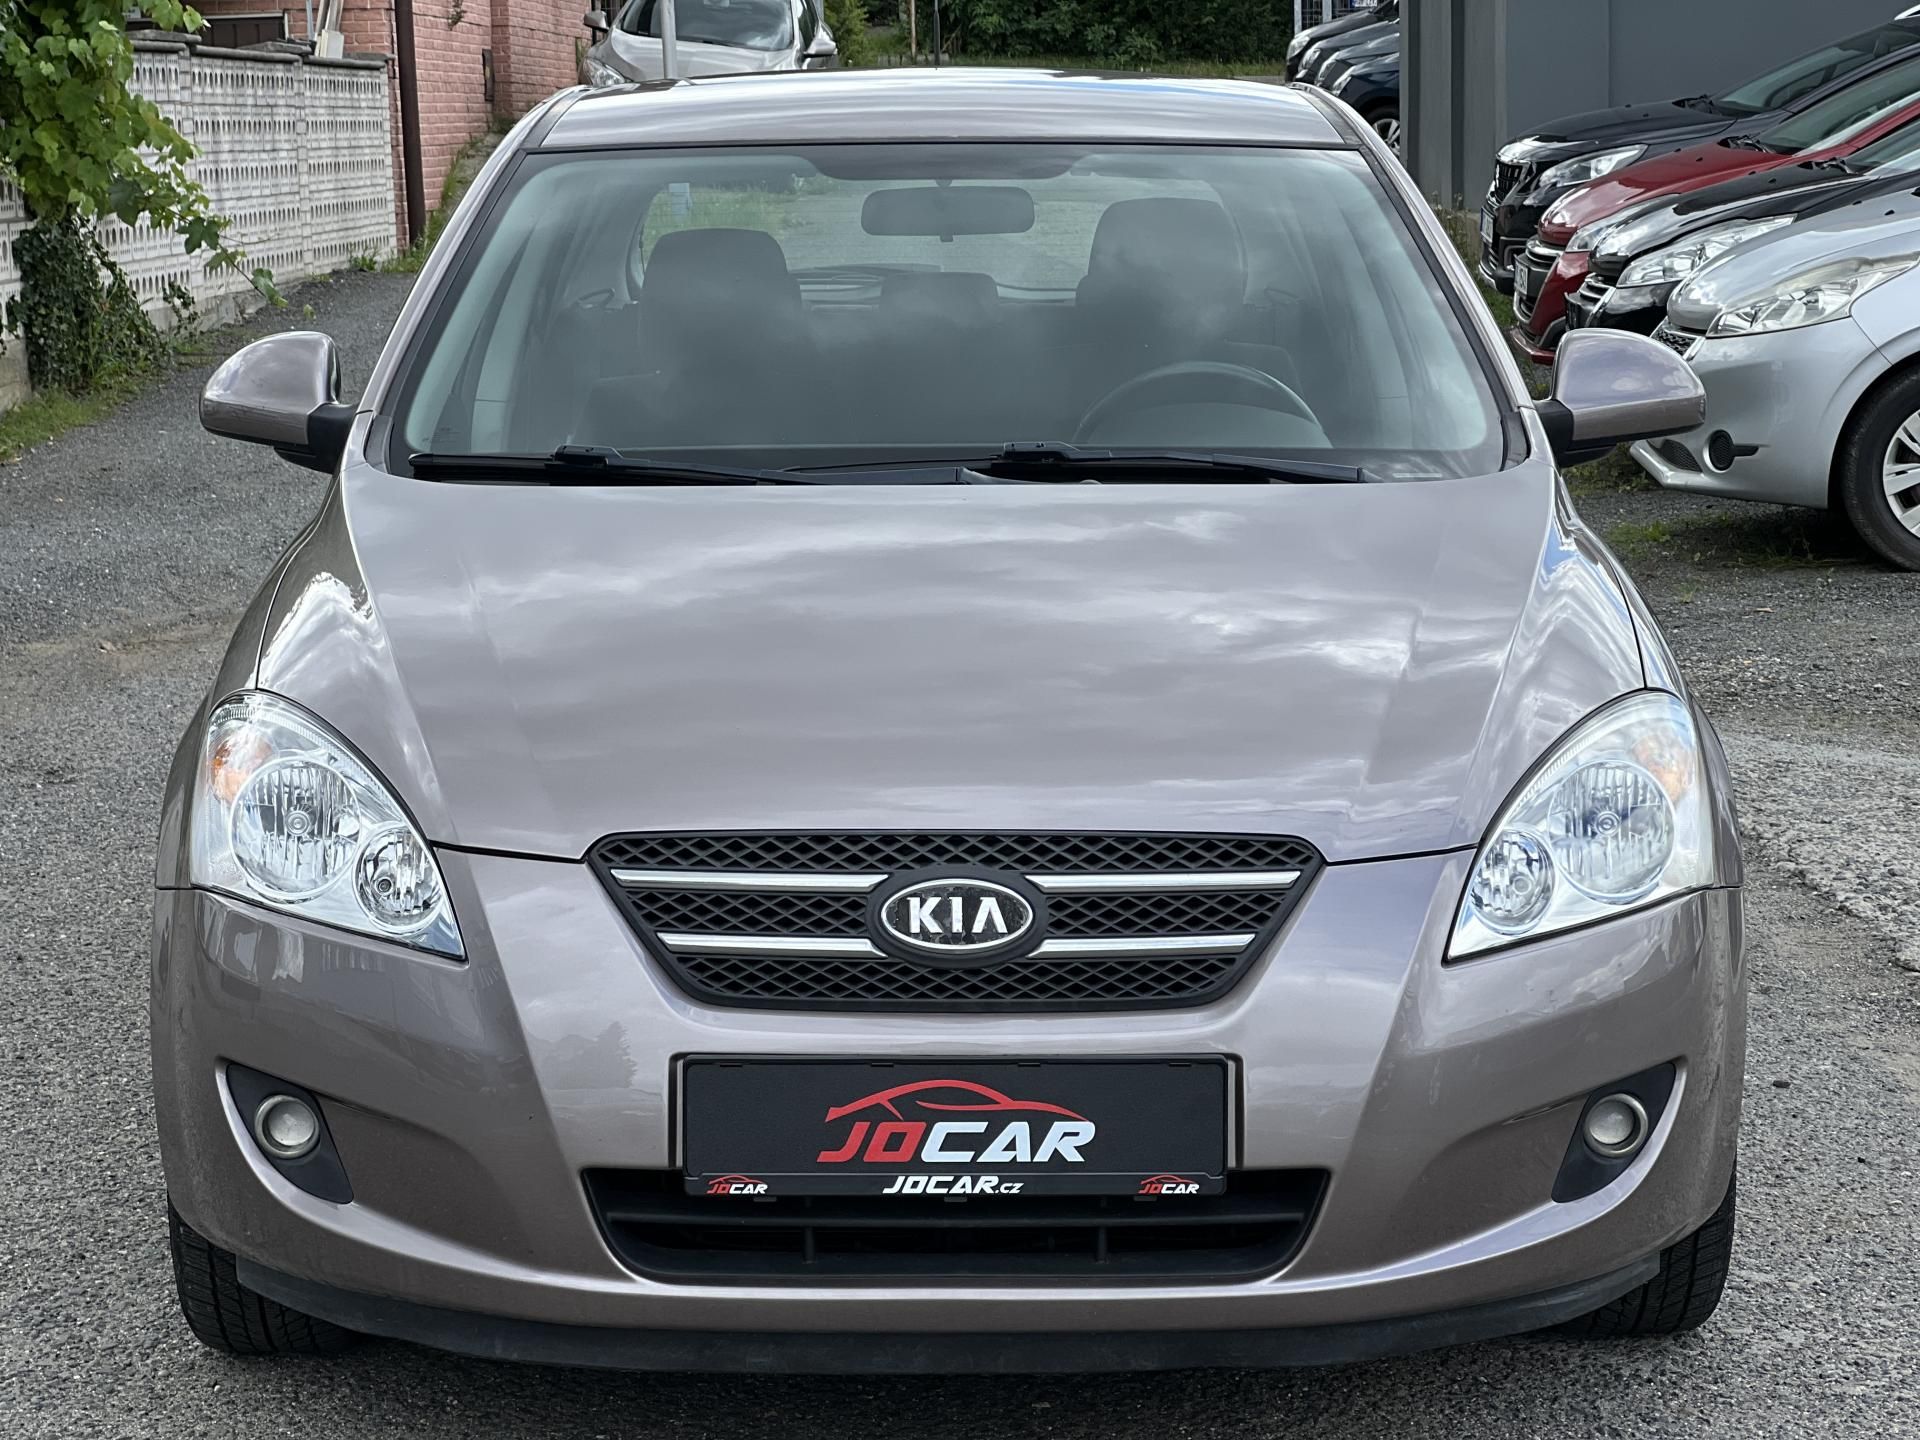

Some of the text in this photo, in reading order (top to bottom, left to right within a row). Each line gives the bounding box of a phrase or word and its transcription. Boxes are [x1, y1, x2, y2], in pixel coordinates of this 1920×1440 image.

[906, 896, 1008, 933] KIA
[816, 1121, 1096, 1163] JOCAR
[706, 1183, 768, 1194] JOCAR
[1138, 1183, 1199, 1194] JOCAR
